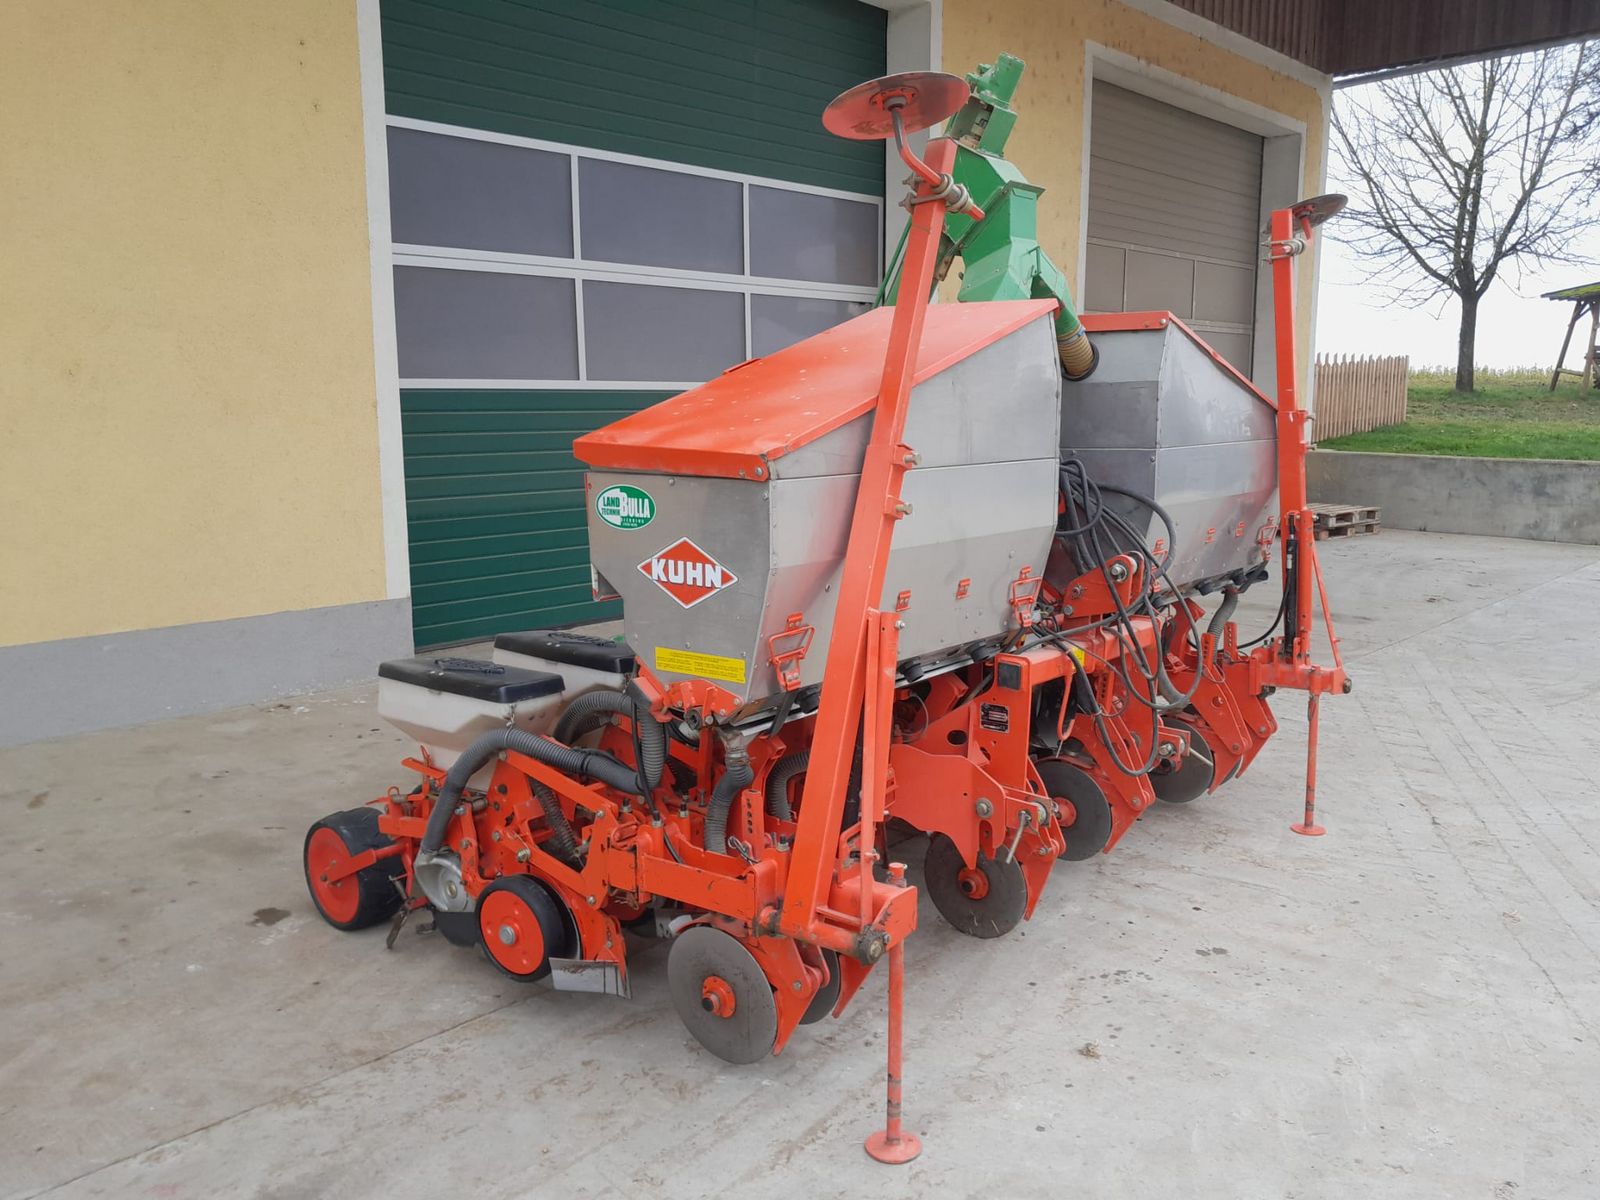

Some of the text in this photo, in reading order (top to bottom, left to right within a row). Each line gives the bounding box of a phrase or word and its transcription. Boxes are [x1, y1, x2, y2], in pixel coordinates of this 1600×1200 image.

[602, 496, 620, 507] LAND
[620, 492, 651, 519] BULLA
[651, 557, 722, 588] KUHN
